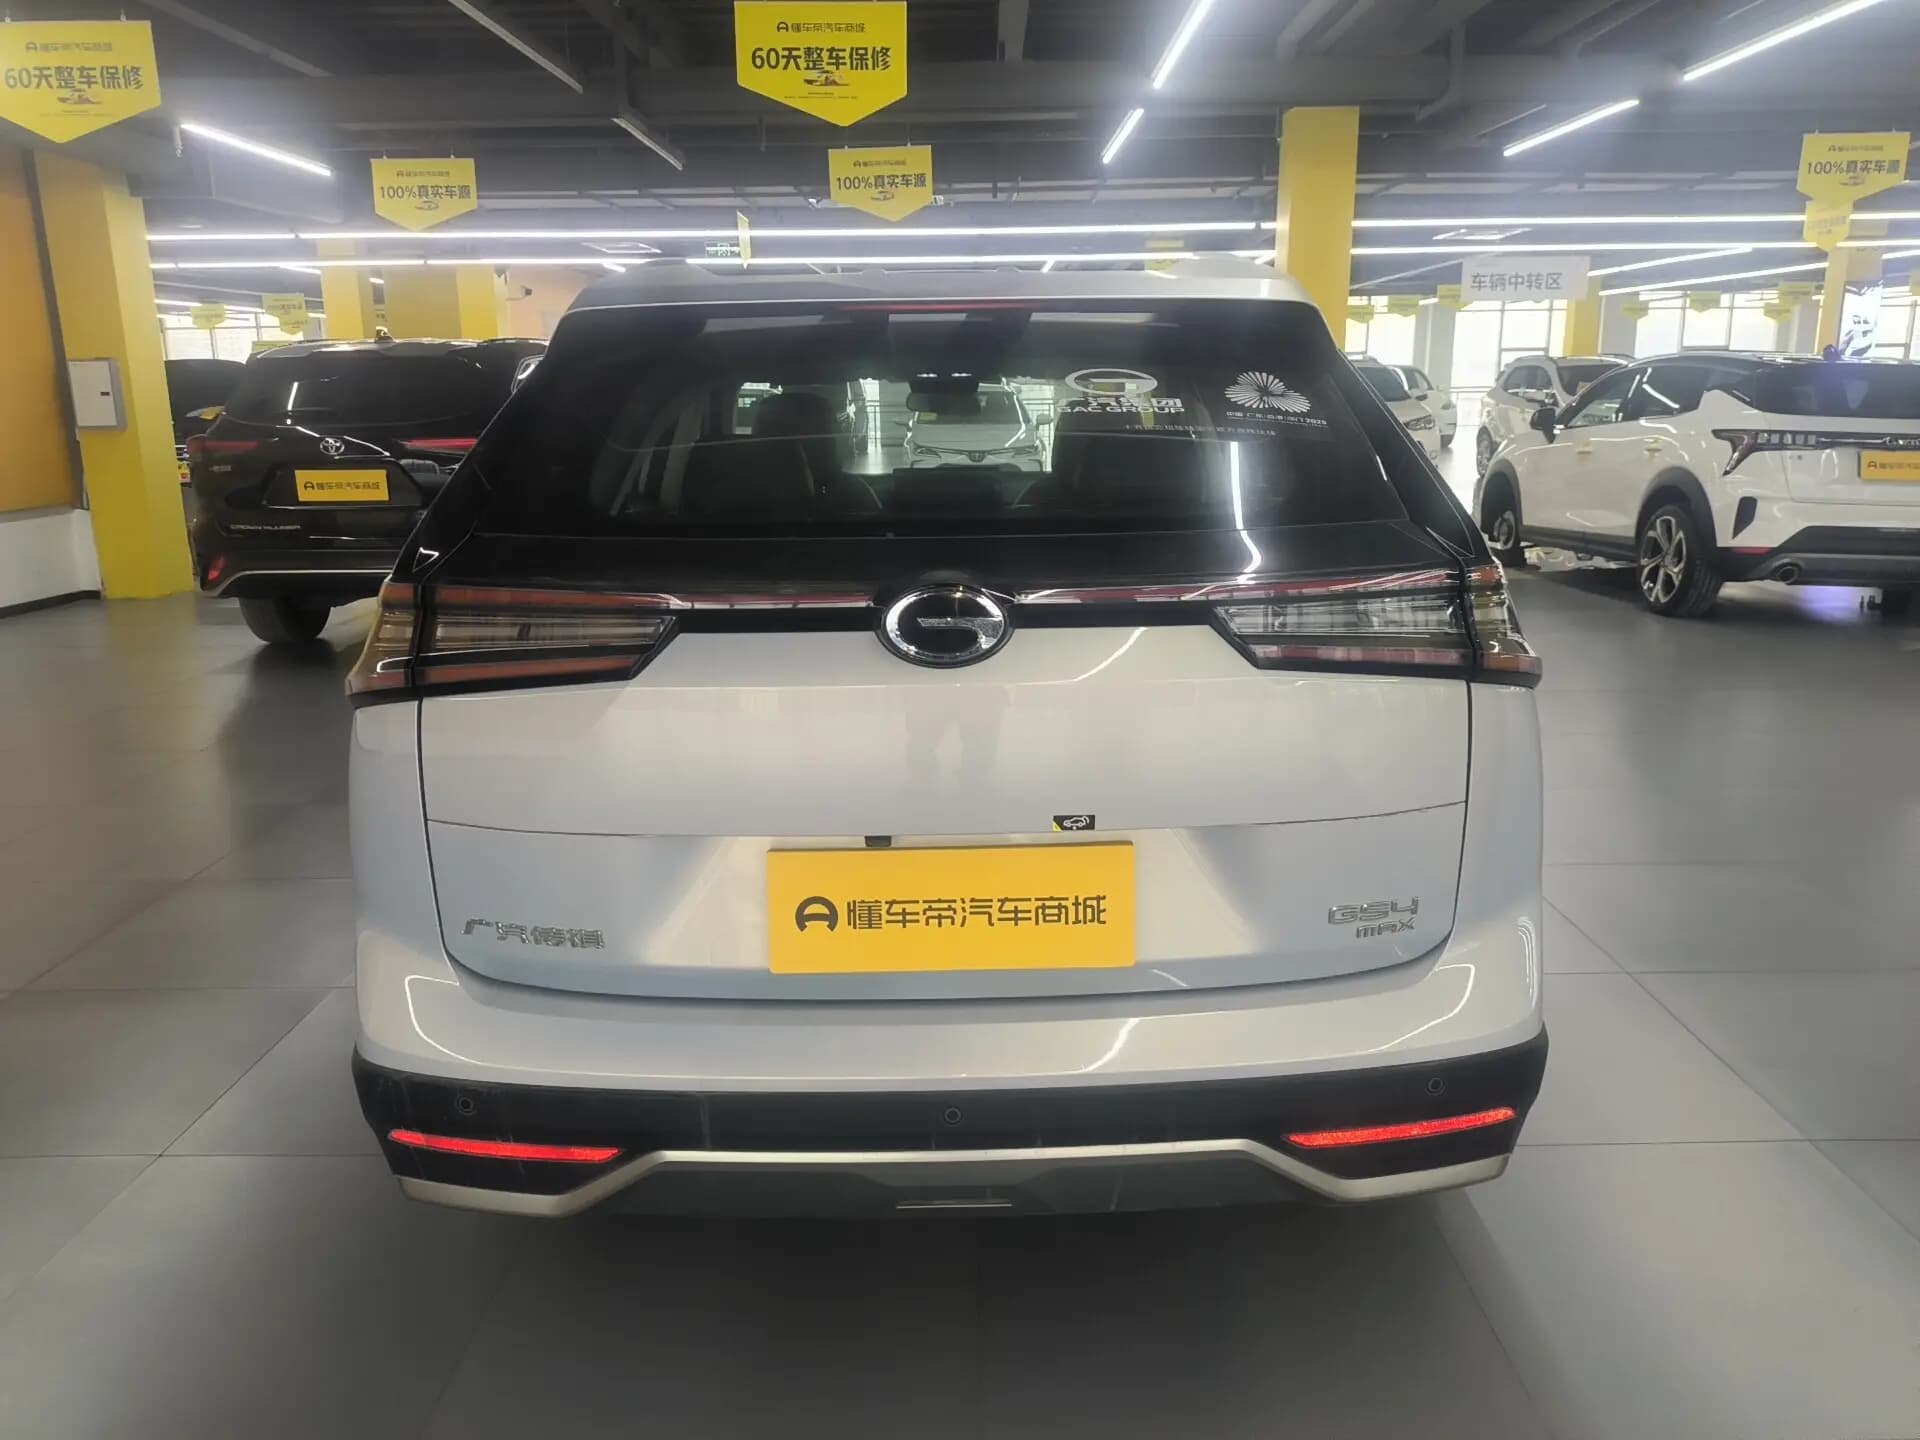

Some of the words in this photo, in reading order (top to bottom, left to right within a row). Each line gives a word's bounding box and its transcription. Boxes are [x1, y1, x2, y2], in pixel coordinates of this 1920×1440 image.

[751, 46, 892, 71] 60天整车保修
[4, 65, 145, 90] 60天整车保修
[379, 184, 472, 200] 100%真实车源
[835, 173, 928, 191] 100%真实车源
[1470, 271, 1563, 292] 车辆中转区
[1056, 405, 1103, 413] GAC
[1106, 405, 1185, 414] GROUP
[846, 894, 1107, 930] 懂车帝汽车商城
[1327, 896, 1419, 925] GS4
[461, 918, 606, 950] 广汽传祺
